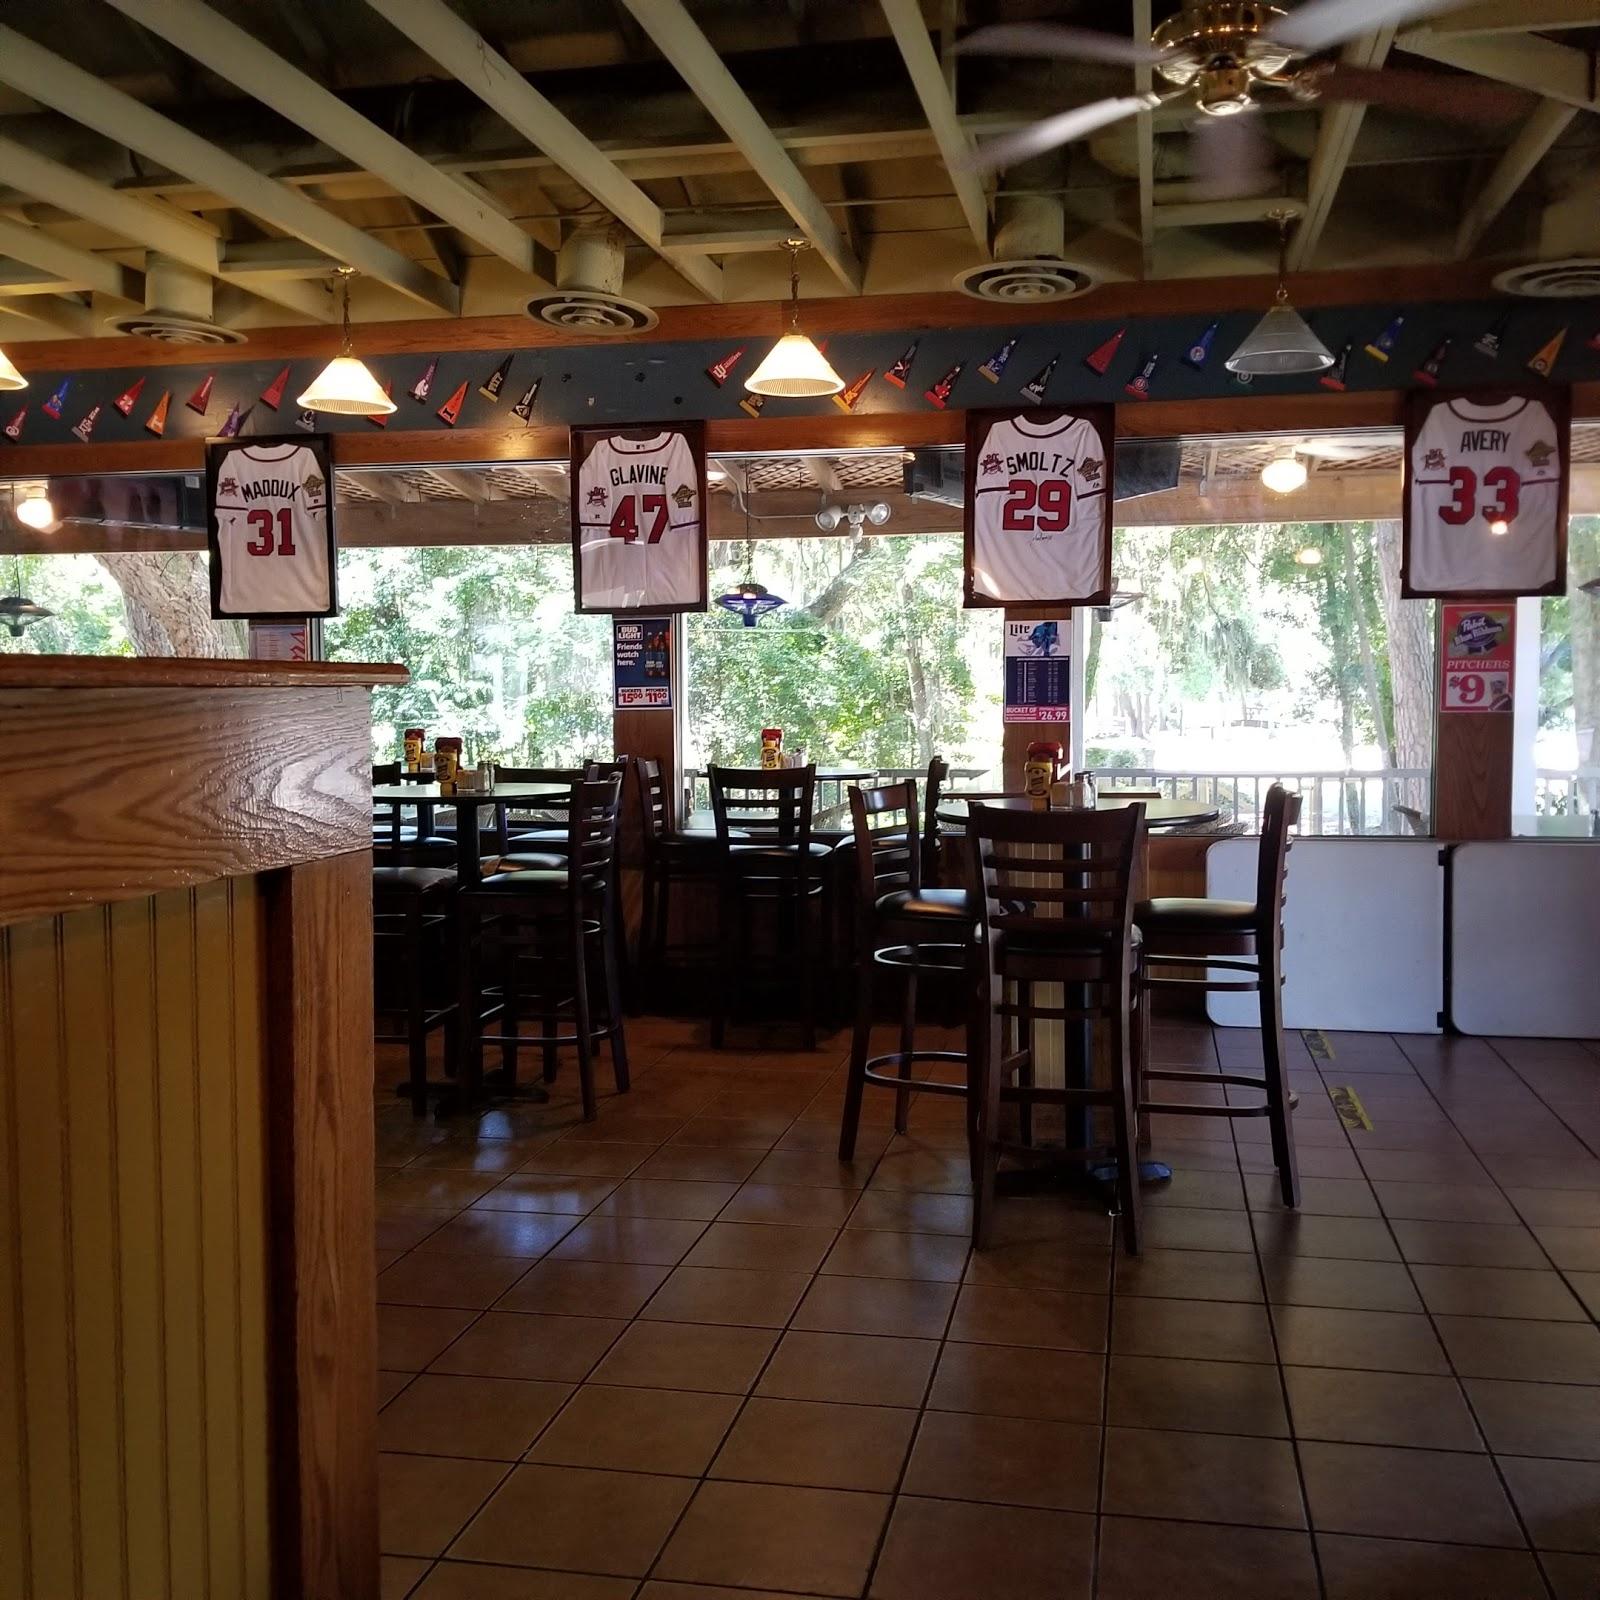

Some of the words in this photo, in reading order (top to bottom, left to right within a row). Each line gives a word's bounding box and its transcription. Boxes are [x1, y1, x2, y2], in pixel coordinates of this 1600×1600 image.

[1460, 430, 1512, 453] AVERY
[1006, 450, 1076, 477] SMOLTZ
[610, 465, 667, 487] GLAVINE
[241, 479, 301, 503] MADDUX
[1438, 466, 1523, 525] 33
[1002, 479, 1072, 532] 29
[609, 494, 670, 544] 47
[246, 507, 296, 557] 31
[1009, 623, 1031, 637] Lite
[1461, 616, 1486, 633] Pabst
[1446, 659, 1511, 670] PITCHERS
[1448, 674, 1485, 704] $9
[1038, 711, 1068, 720] $26.99
